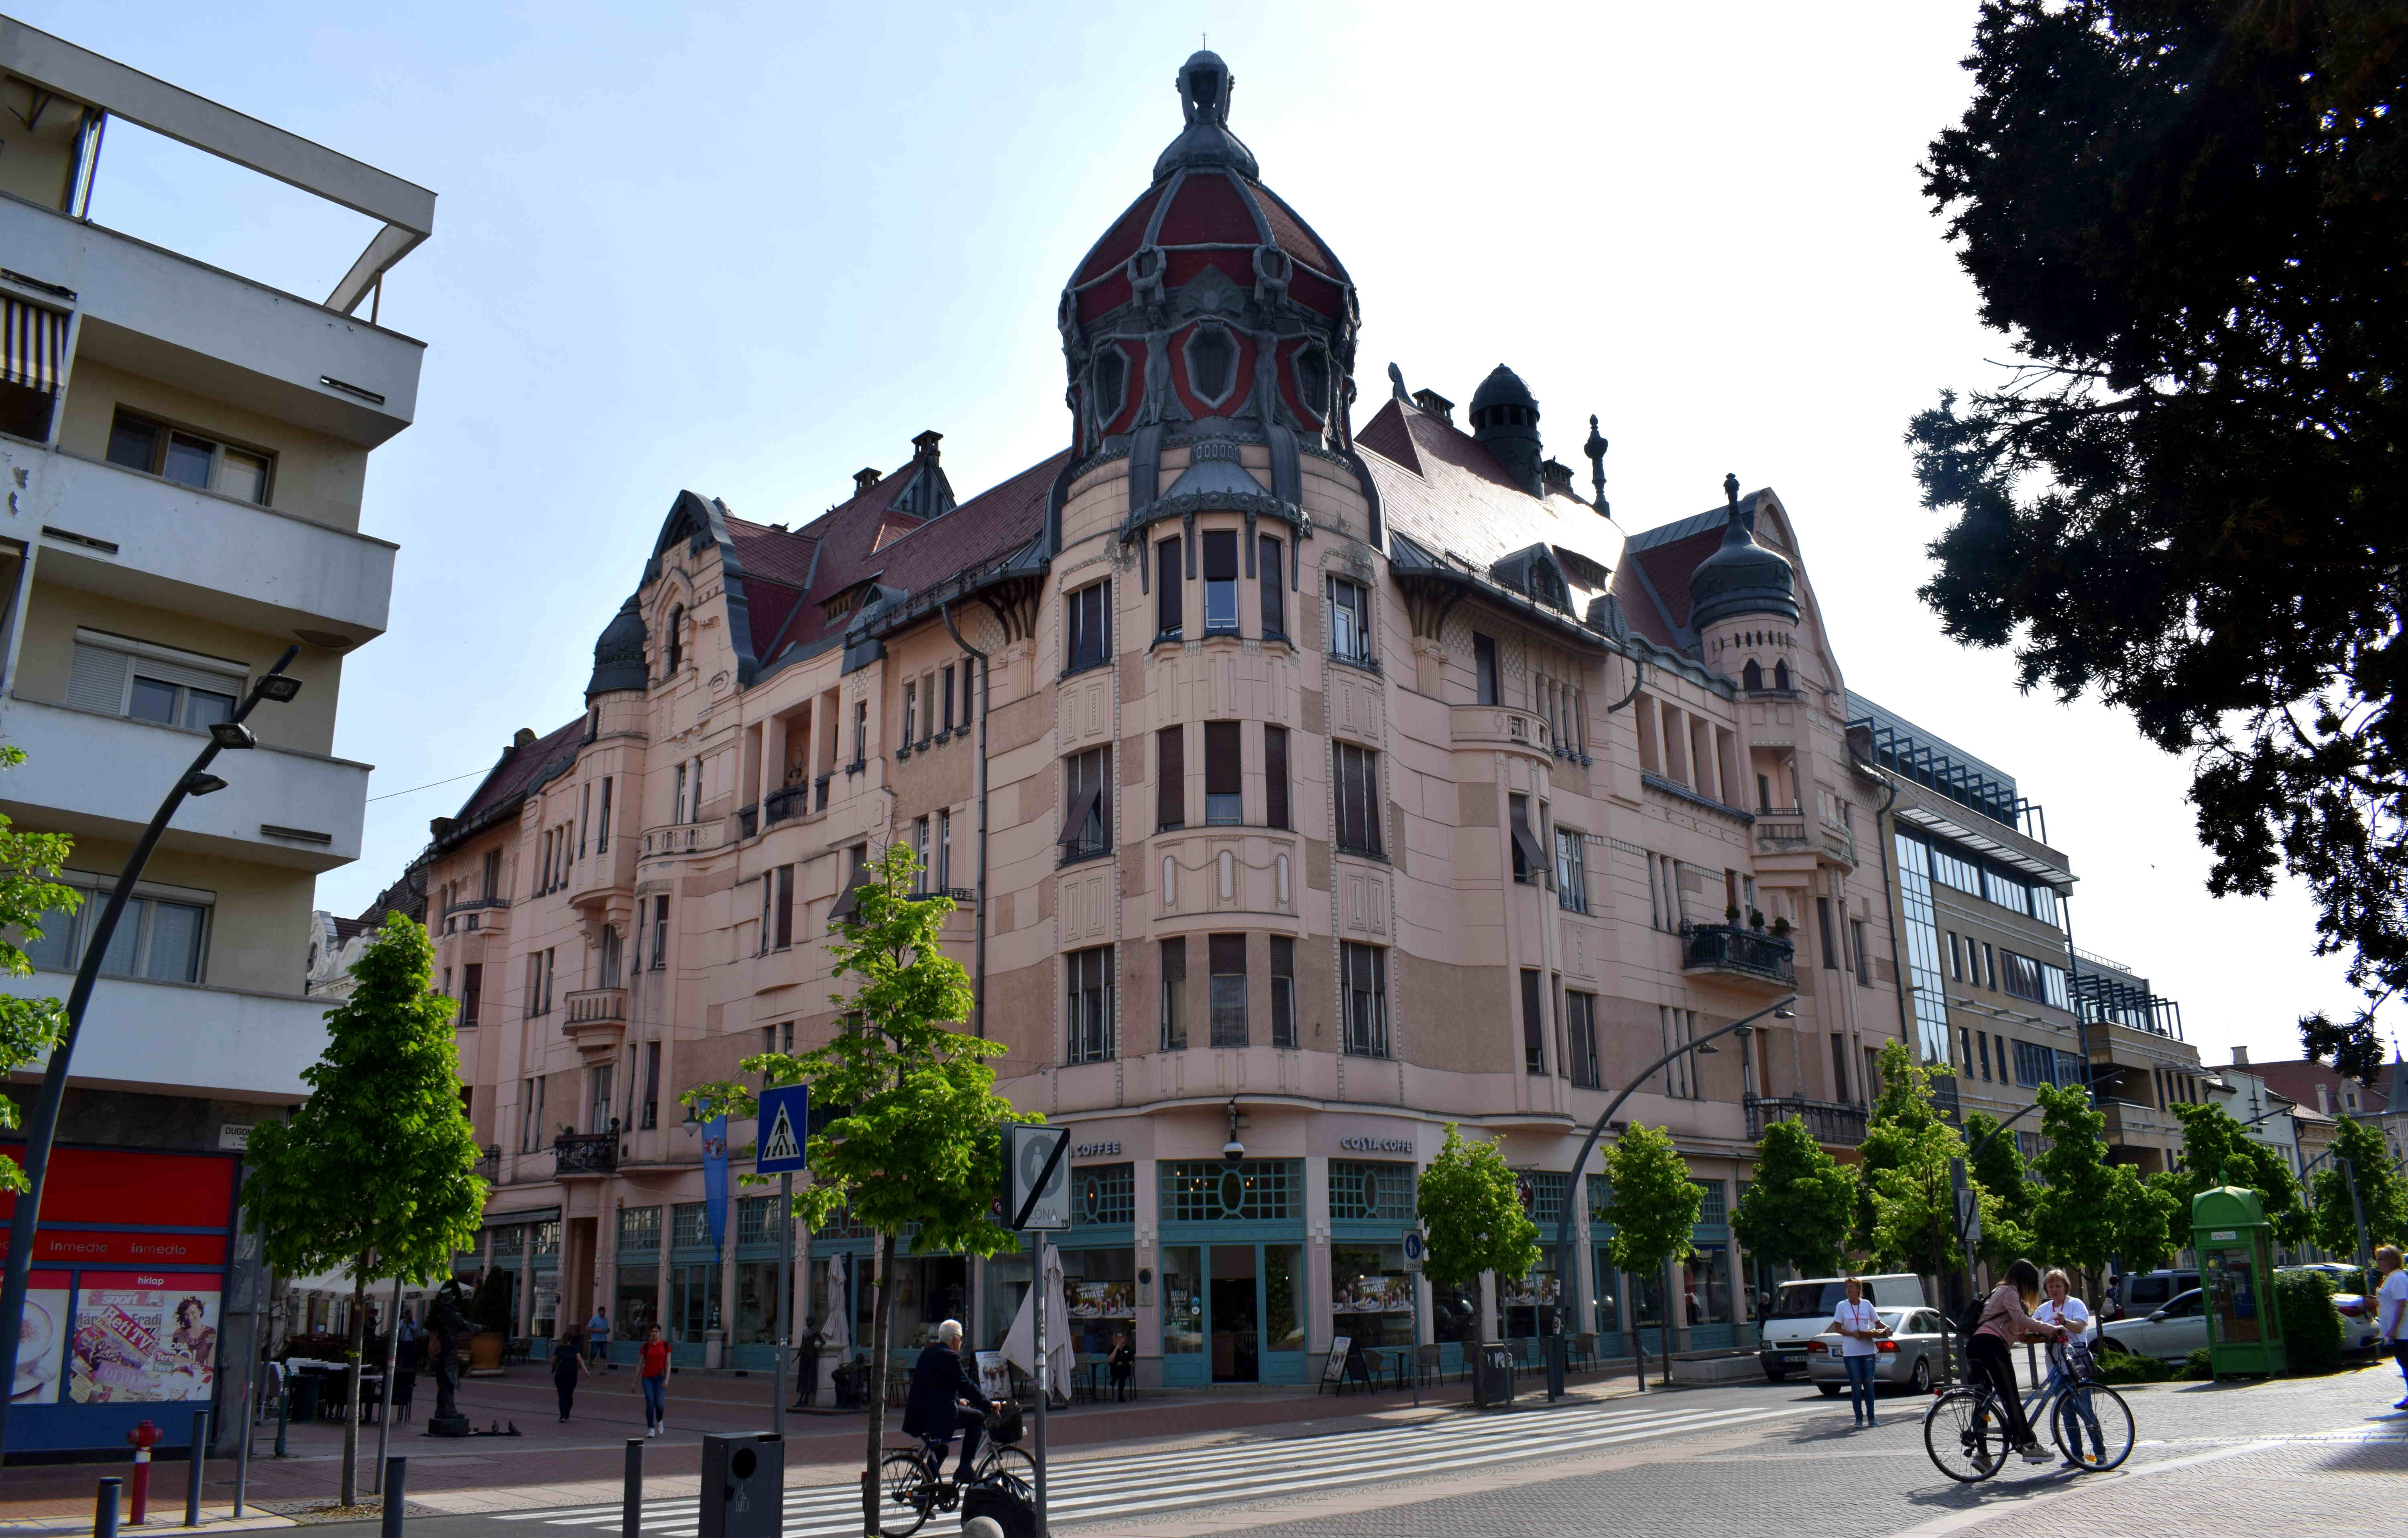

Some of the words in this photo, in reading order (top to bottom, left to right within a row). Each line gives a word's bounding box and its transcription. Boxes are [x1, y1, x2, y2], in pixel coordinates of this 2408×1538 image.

[225, 1127, 254, 1135] DUGON
[1075, 1141, 1120, 1156] COFFEE
[1341, 1136, 1381, 1150] COSTA
[1383, 1139, 1415, 1153] COFFEE
[50, 1240, 108, 1253] inmedio
[130, 1242, 187, 1255] inmedio
[138, 1276, 164, 1286] hírlap
[1080, 1289, 1104, 1299] TAVASZ
[1362, 1284, 1386, 1294] TAVASZ
[103, 1306, 134, 1336] Heti
[129, 1326, 154, 1349] TV
[157, 1352, 175, 1362] Tere
